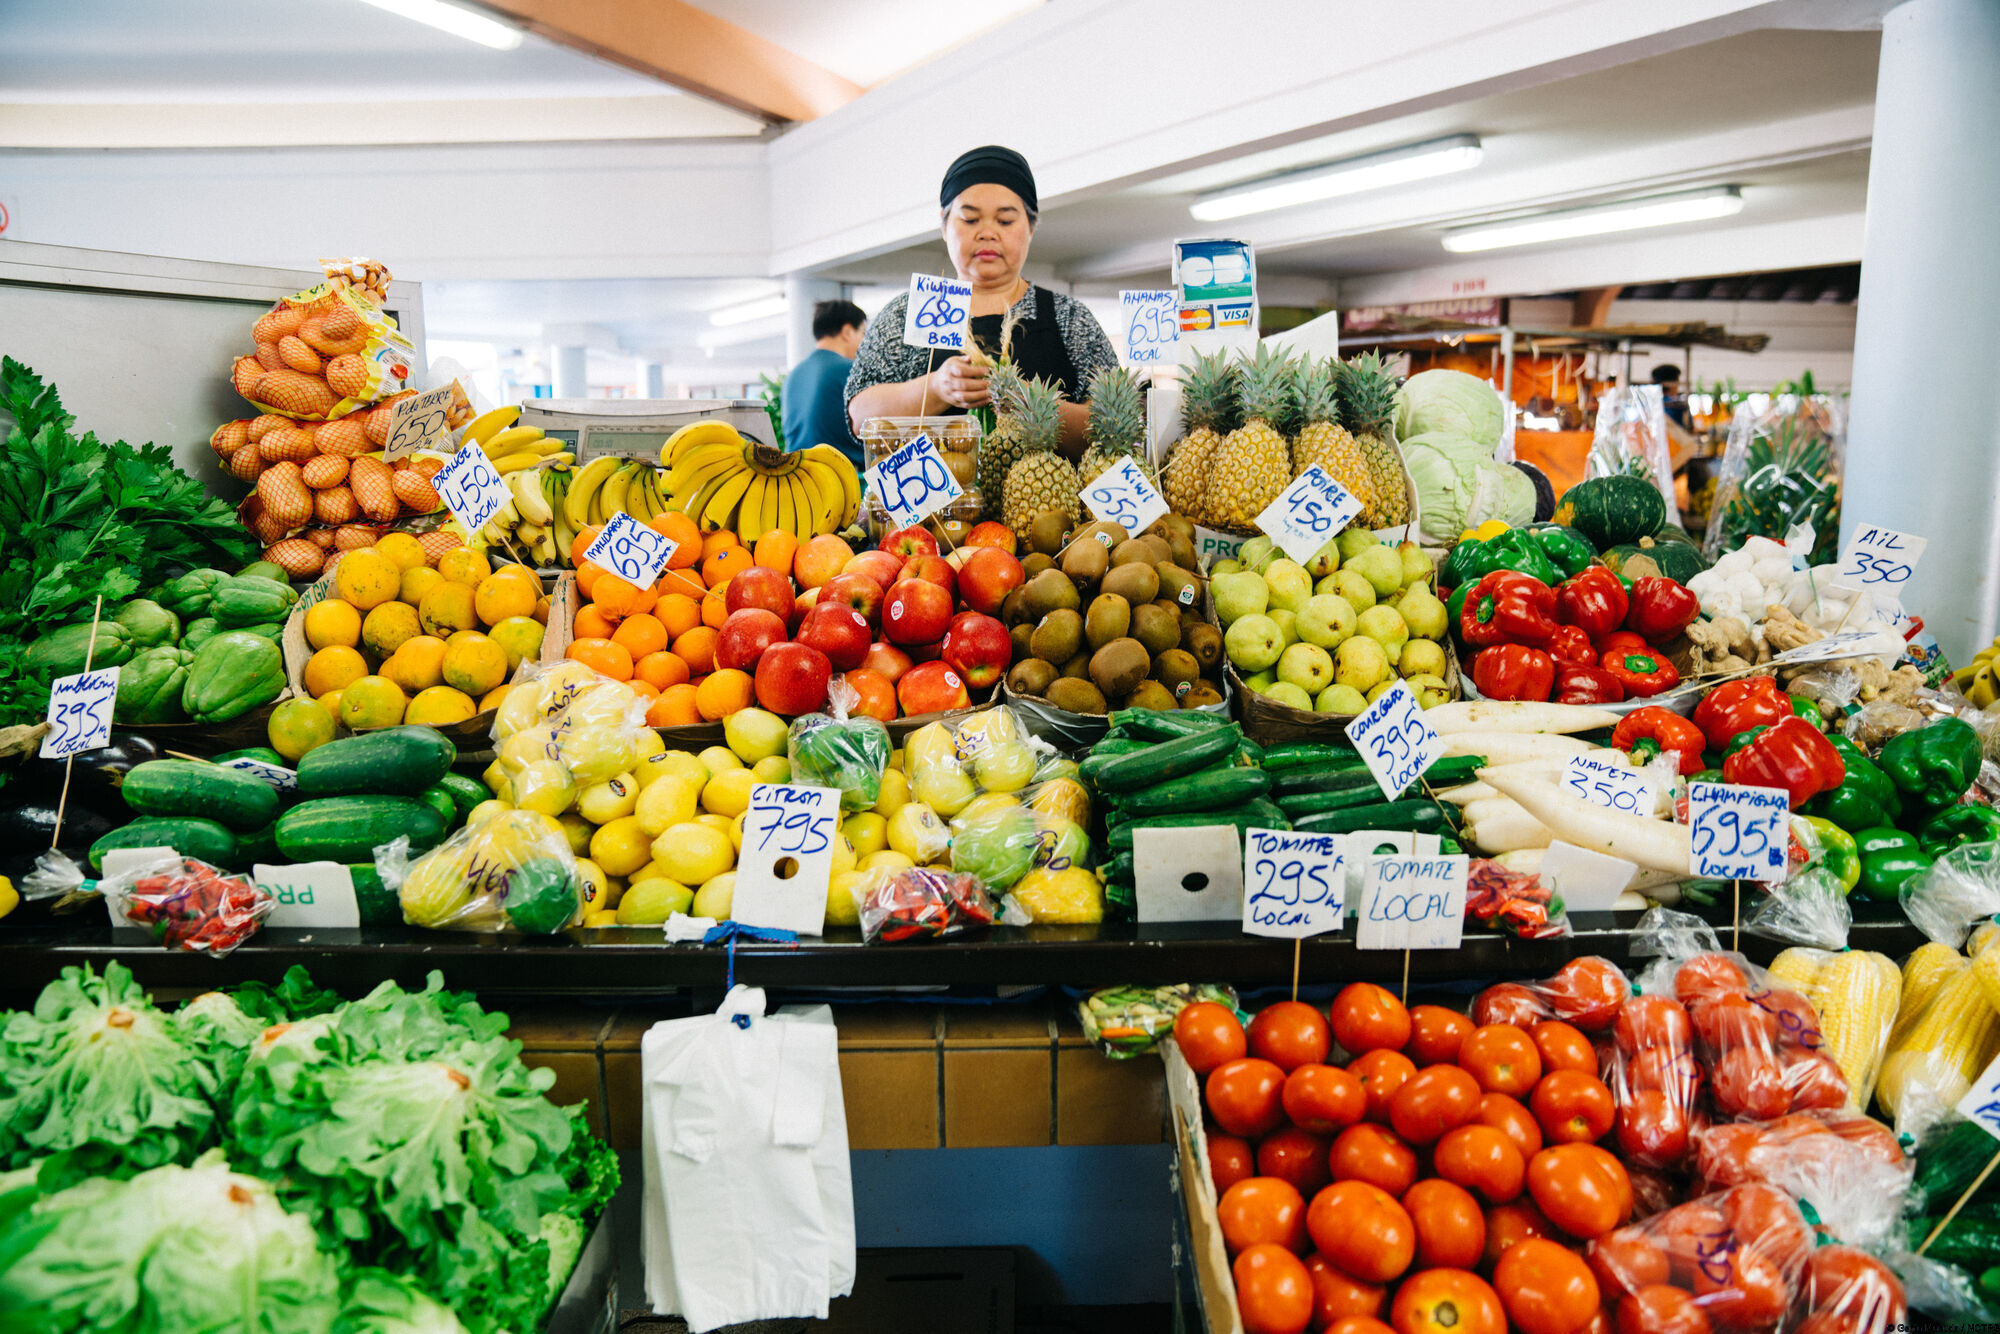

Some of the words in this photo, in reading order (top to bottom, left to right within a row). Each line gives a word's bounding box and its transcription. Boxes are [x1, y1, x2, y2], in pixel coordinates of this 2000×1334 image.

[916, 295, 966, 328] 680
[1123, 291, 1173, 306] ANANAS
[1223, 309, 1249, 320] VISA
[1127, 304, 1177, 346] 695
[1128, 346, 1162, 361] LOCAL
[388, 409, 446, 453] 650
[432, 446, 472, 491] ORANGE
[445, 464, 490, 512] 450
[877, 455, 950, 514] 450
[1092, 486, 1138, 530] 650
[1287, 484, 1331, 533] 450
[608, 520, 659, 580] 695
[1843, 551, 1913, 584] 350
[50, 696, 108, 747] 395
[1370, 706, 1425, 776] 395
[1570, 755, 1637, 781] NAVET
[1569, 770, 1637, 810] 350
[753, 805, 834, 854] 795
[1249, 858, 1329, 906] 295
[1371, 857, 1457, 883] TOMATE
[1700, 856, 1759, 880] LOCAL
[1252, 905, 1312, 926] LOCAL
[1368, 886, 1457, 922] LOCAL
